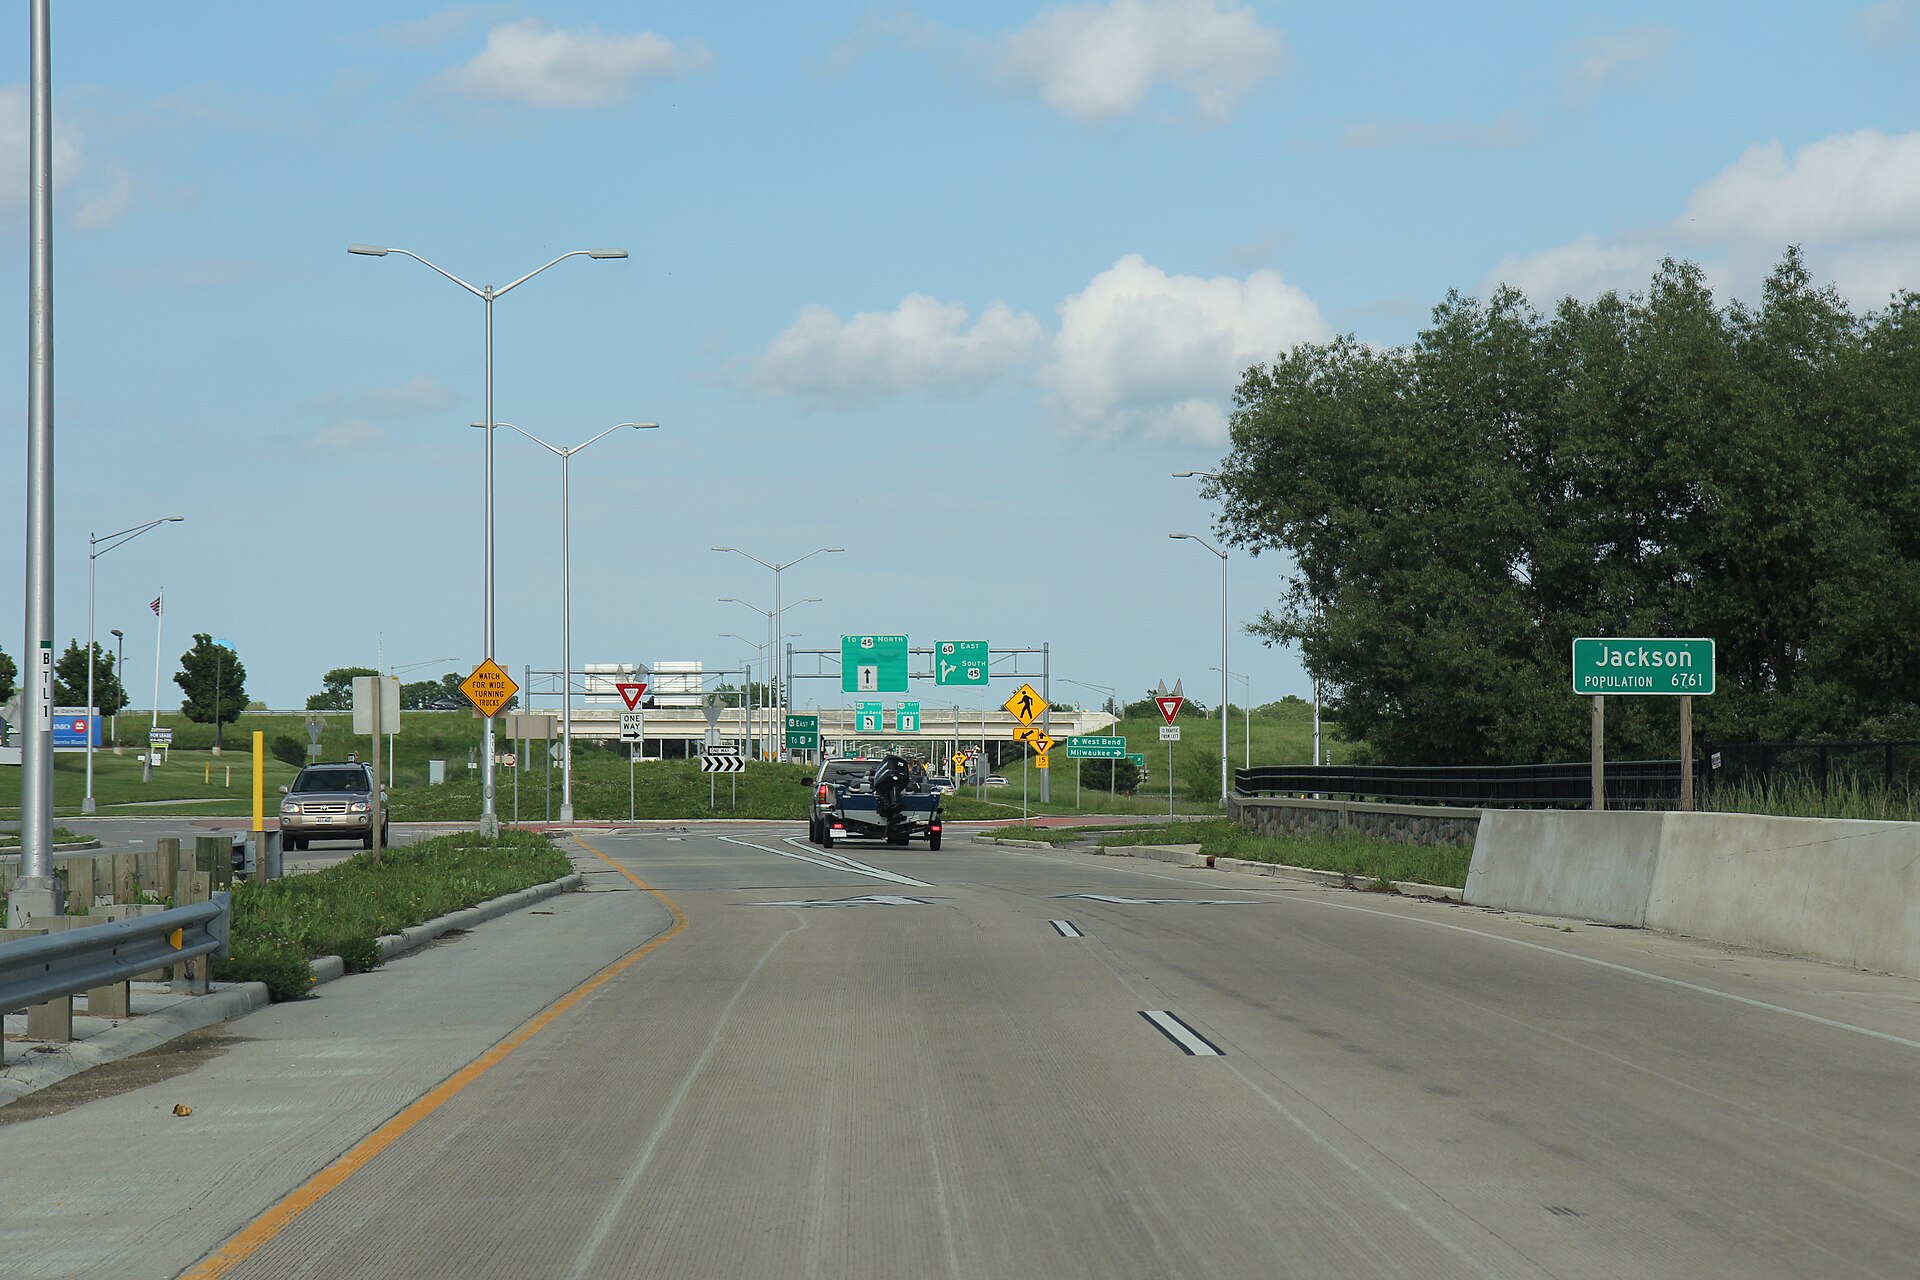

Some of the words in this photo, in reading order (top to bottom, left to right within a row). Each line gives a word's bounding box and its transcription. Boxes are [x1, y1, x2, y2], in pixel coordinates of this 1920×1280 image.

[862, 639, 873, 647] 45
[1595, 646, 1692, 667] Jackson
[968, 670, 979, 678] 45
[1584, 676, 1653, 687] POPULATION
[1671, 673, 1702, 687] 6761
